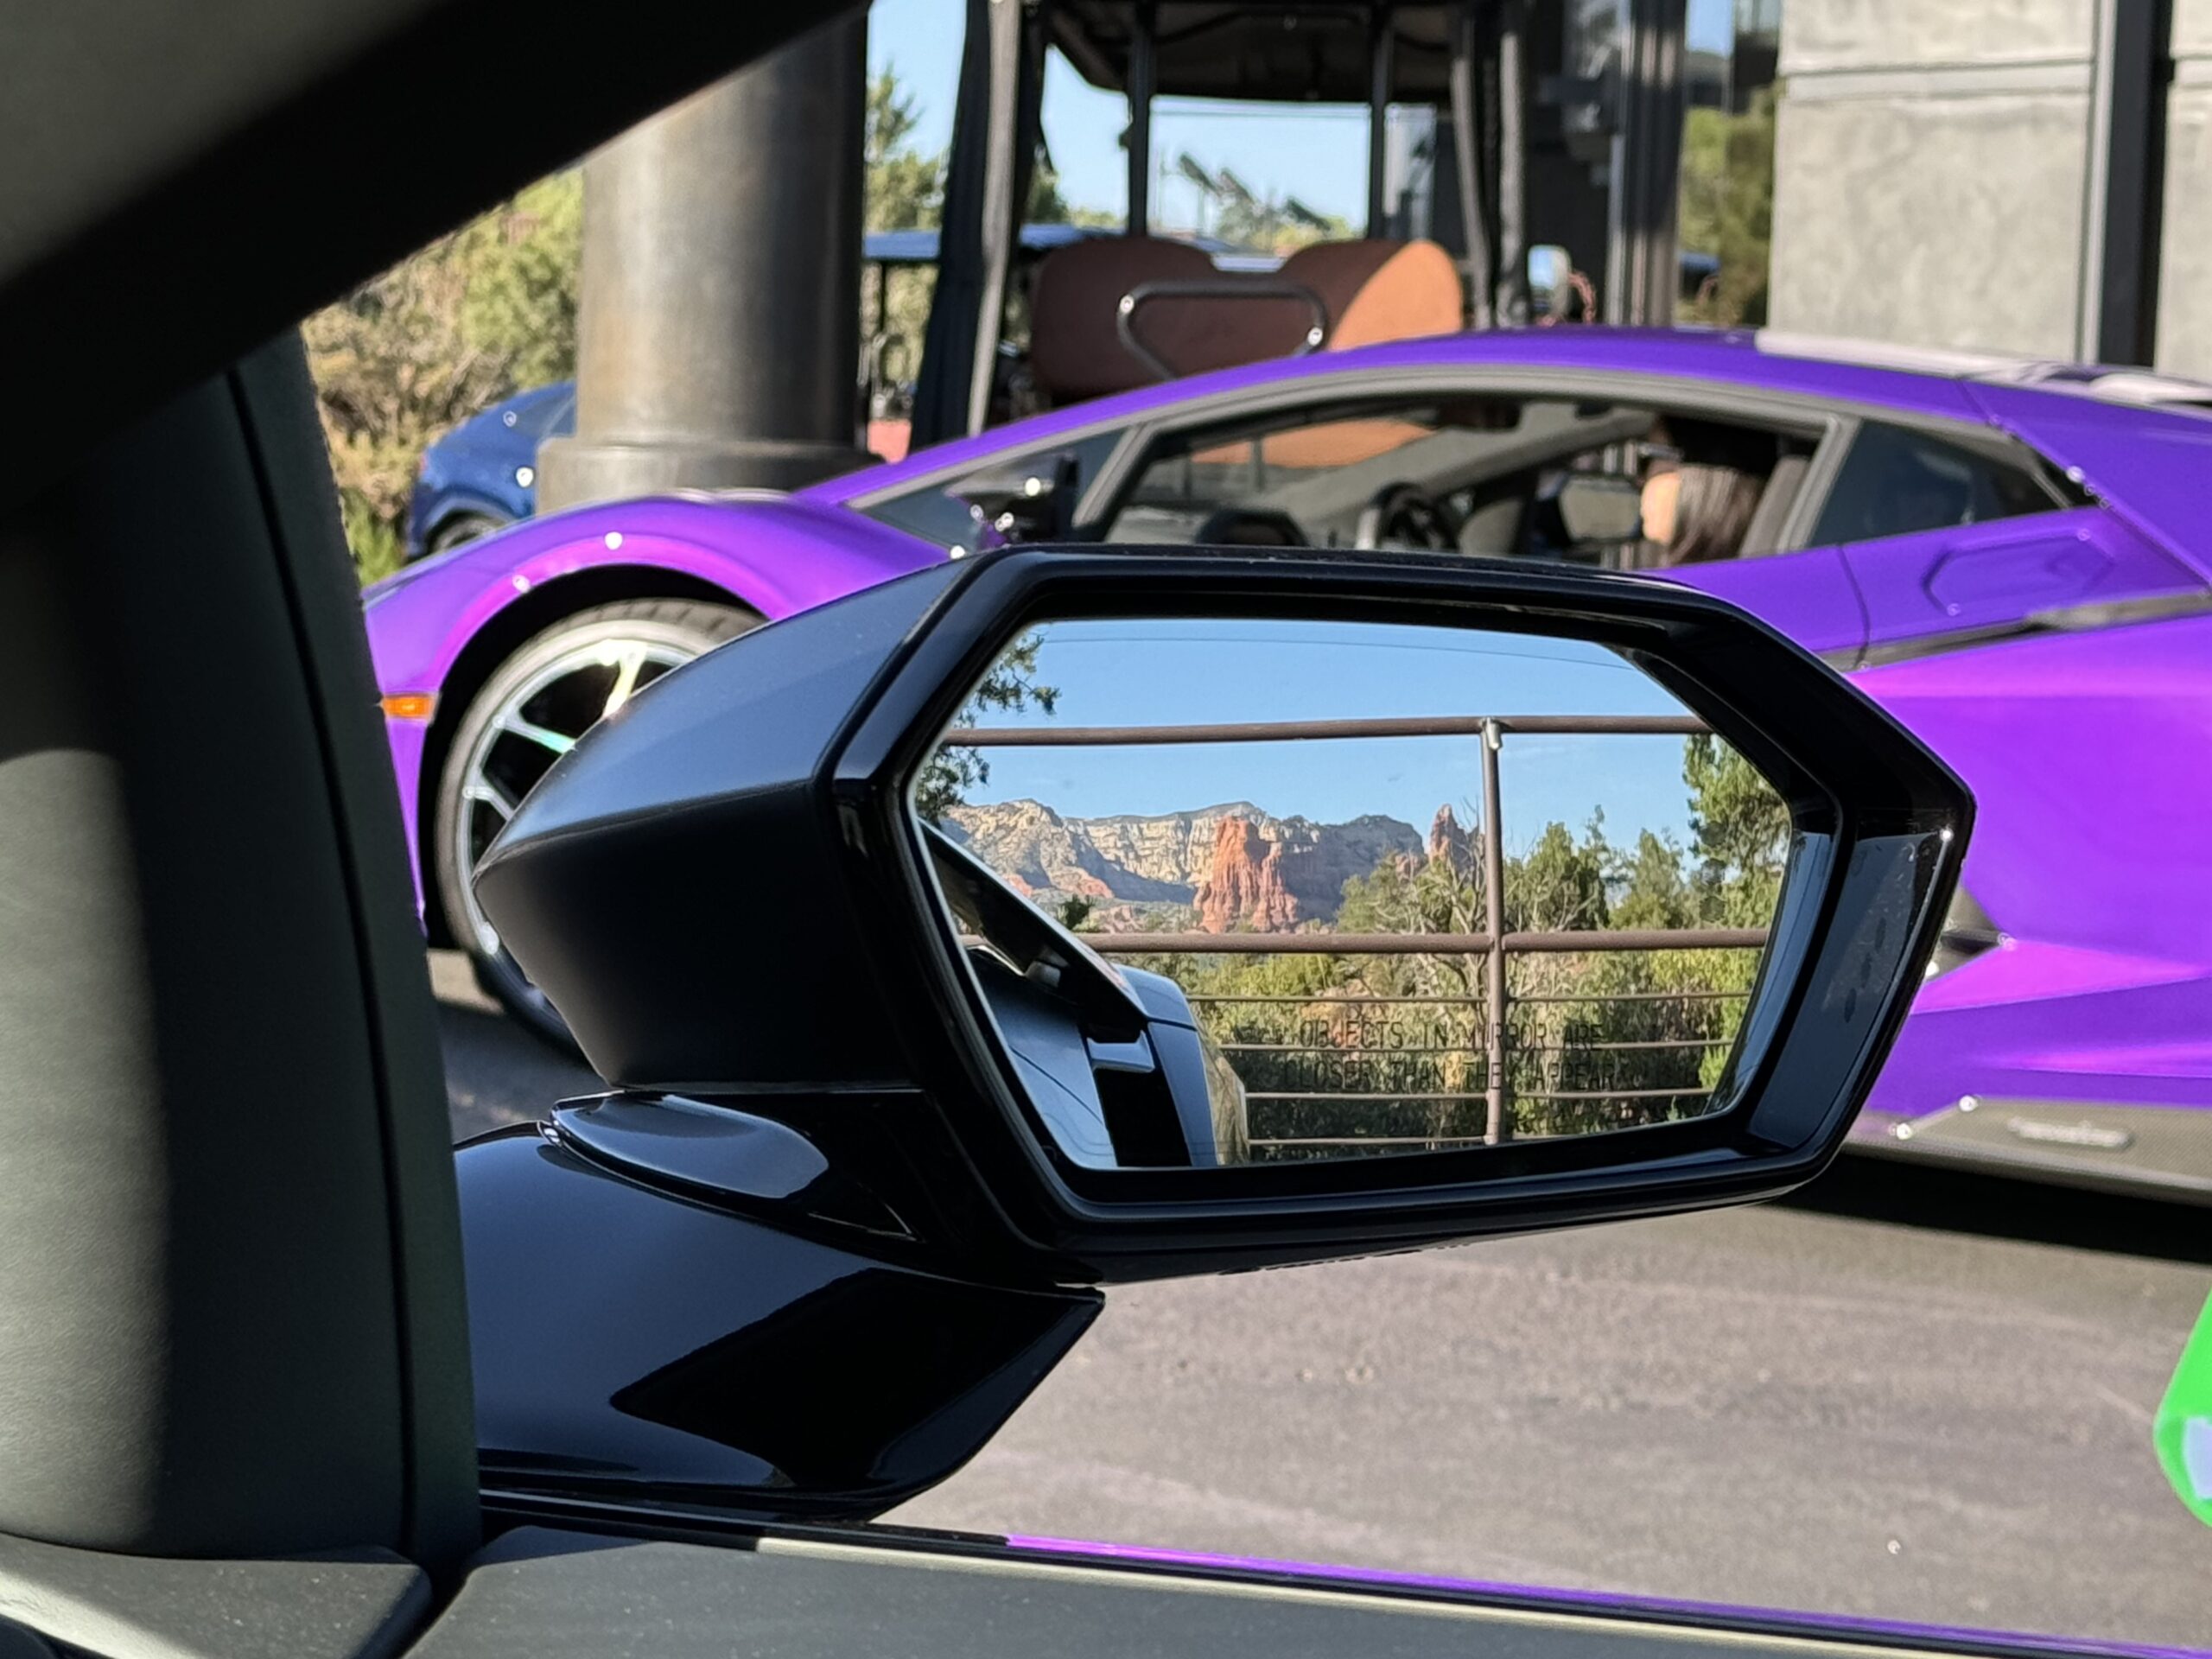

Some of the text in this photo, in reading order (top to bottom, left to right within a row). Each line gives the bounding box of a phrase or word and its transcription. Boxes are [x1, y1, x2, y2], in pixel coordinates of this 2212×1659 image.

[1300, 1020, 1604, 1052] OBJECTS IN MIRROR ARE
[1285, 1059, 1614, 1090] CLOSER THAN THEY APPEAR
